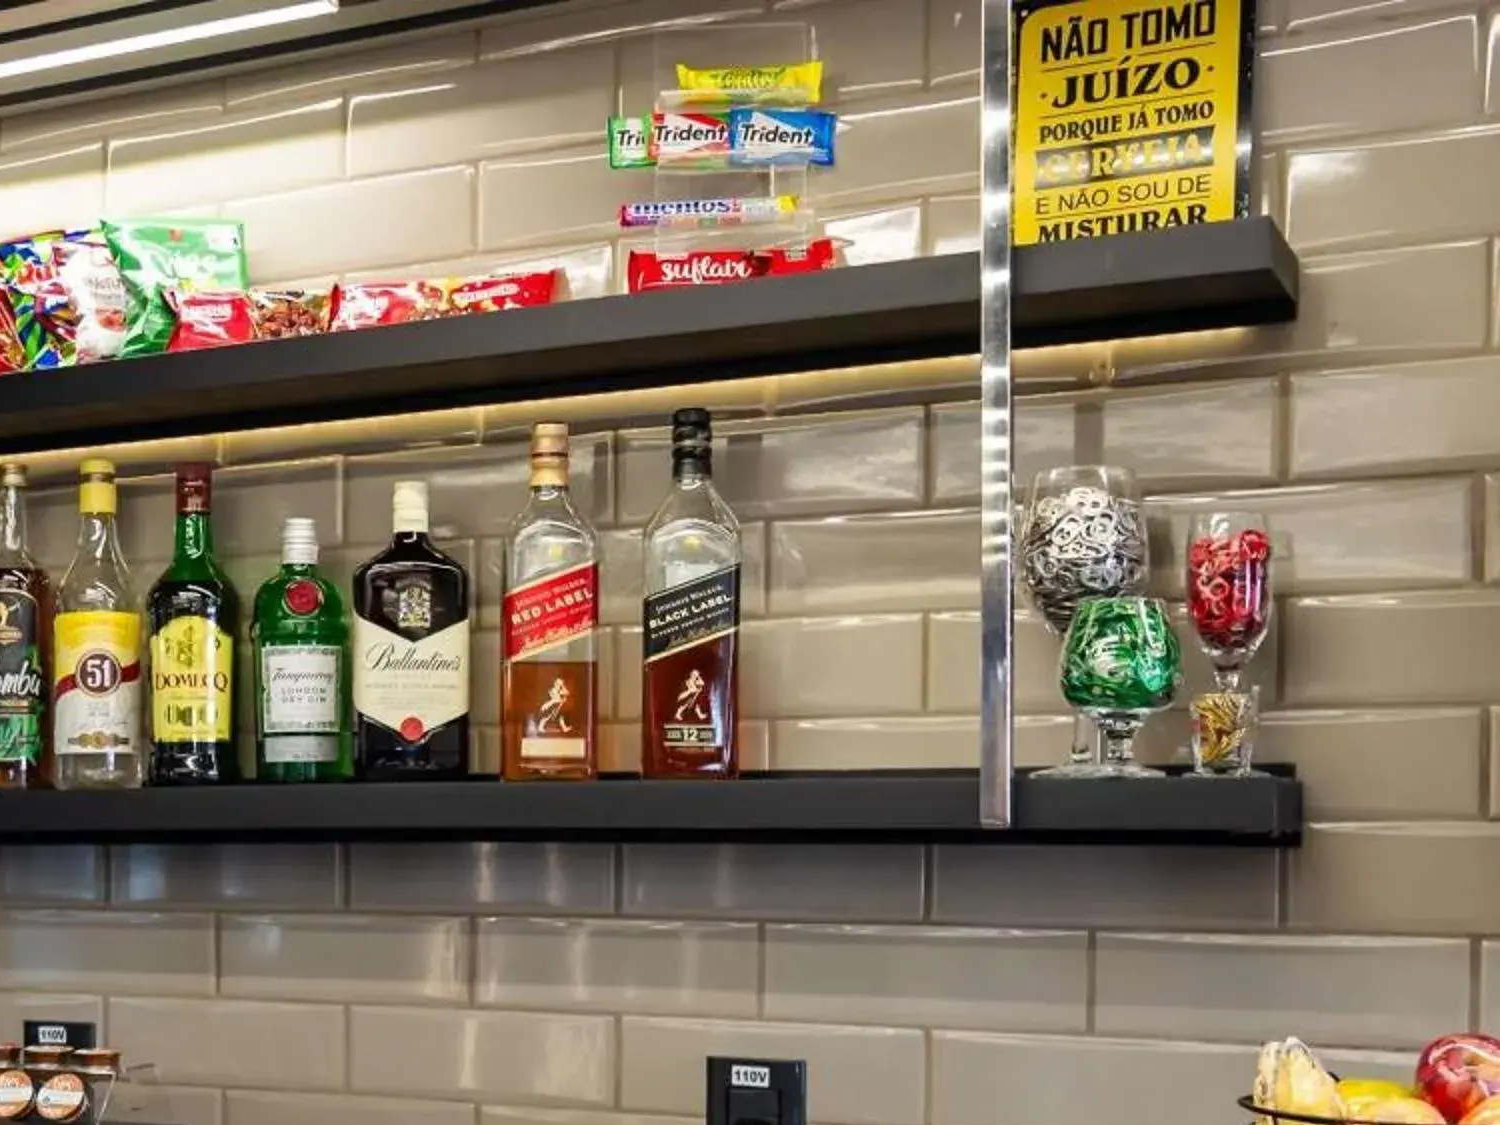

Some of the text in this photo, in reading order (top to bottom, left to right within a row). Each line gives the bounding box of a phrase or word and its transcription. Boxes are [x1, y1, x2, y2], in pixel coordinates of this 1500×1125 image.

[1040, 2, 1216, 64] NÃO TOMO
[1051, 55, 1200, 108] JUÍZO
[654, 122, 727, 143] Trident
[741, 121, 813, 147] Trident
[1039, 100, 1215, 144] PORQUE JÁ TOMO
[633, 201, 731, 213] mentos
[1036, 173, 1212, 215] E NÃO SOU DE
[1038, 204, 1208, 243] MISTURAR
[661, 256, 750, 284] suflair
[511, 606, 541, 625] RED
[545, 587, 593, 613] LABEL
[649, 608, 689, 629] BLACK
[691, 594, 733, 613] LABEL
[86, 660, 112, 687] 51
[684, 728, 698, 742] 12
[40, 1027, 66, 1043] 110V
[733, 1069, 768, 1083] 110V
